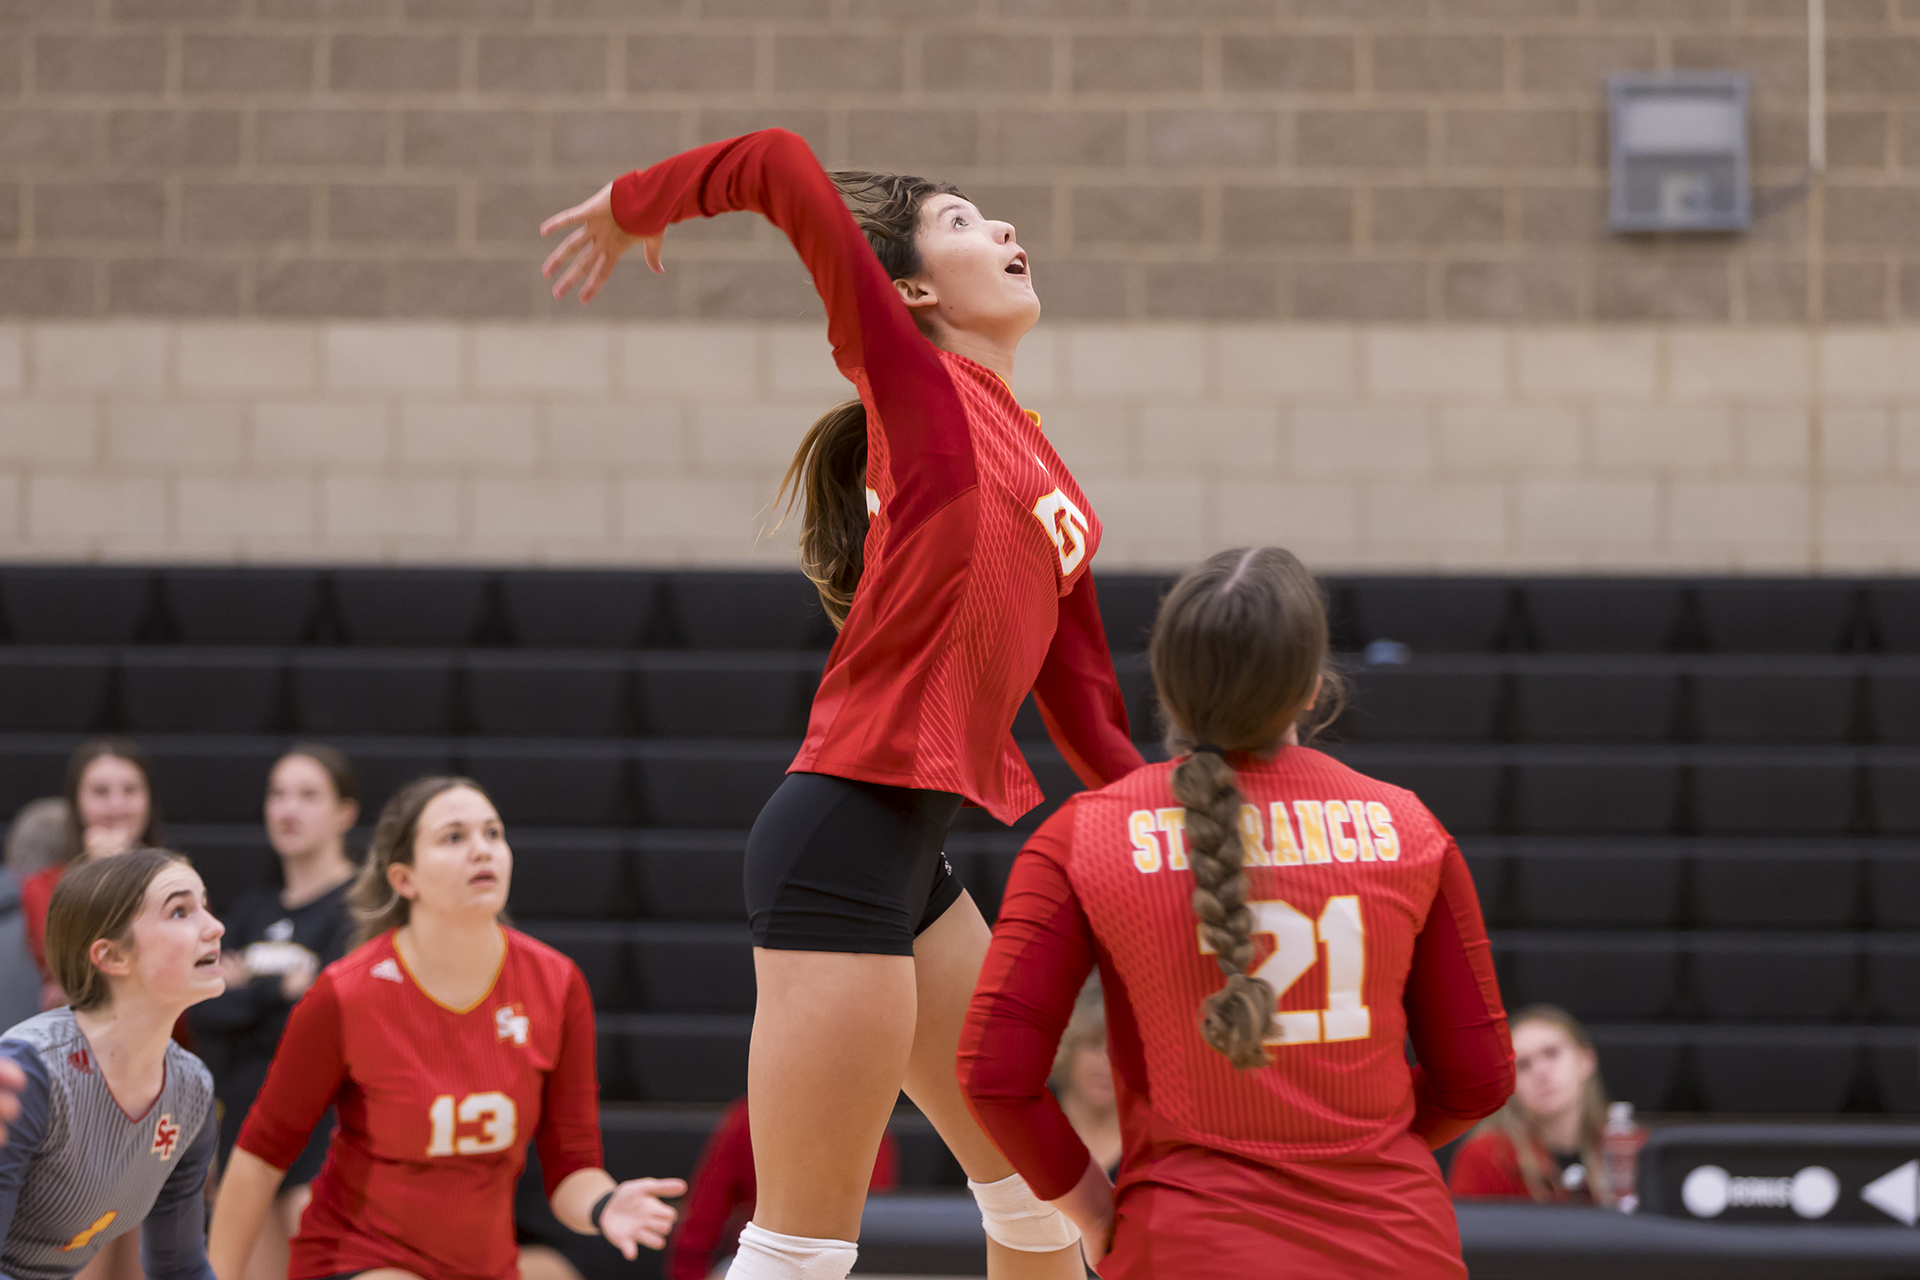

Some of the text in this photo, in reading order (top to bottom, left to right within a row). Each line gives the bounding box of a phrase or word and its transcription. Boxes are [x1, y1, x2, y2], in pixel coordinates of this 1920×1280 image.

[1236, 799, 1401, 868] RANCIS
[1196, 895, 1371, 1046] 21
[151, 1113, 180, 1162] SF
[425, 1088, 518, 1157] 13
